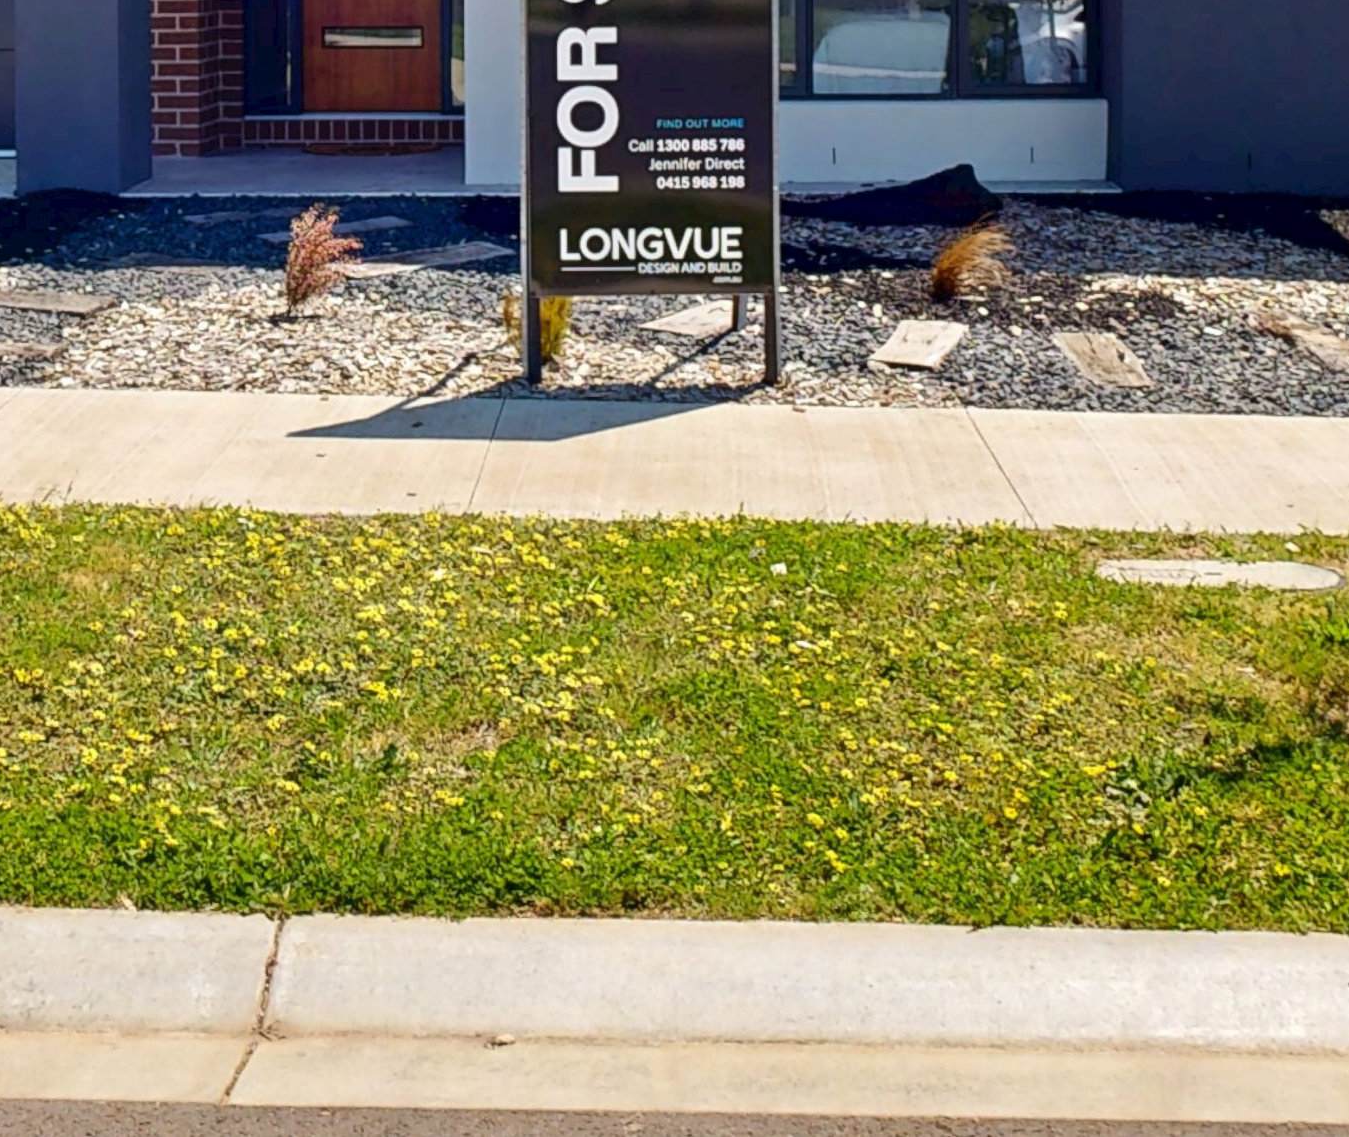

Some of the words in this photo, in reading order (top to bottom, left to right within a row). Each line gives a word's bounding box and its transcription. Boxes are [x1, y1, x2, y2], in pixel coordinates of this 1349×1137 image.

[556, 26, 619, 192] FOR
[655, 118, 683, 129] FIND
[685, 118, 709, 129] OUT
[711, 118, 745, 129] MORE
[628, 139, 654, 152] Call
[656, 139, 690, 152] 1300
[692, 138, 717, 152] 885
[648, 157, 703, 171] Jennifer
[704, 157, 745, 170] Direct
[656, 176, 690, 189] 0415
[692, 176, 717, 189] 968
[719, 175, 745, 188] 198
[559, 227, 743, 261] LONGVUE
[638, 262, 680, 274] DESIGN
[681, 262, 706, 273] AND
[707, 262, 742, 274] BUILD
